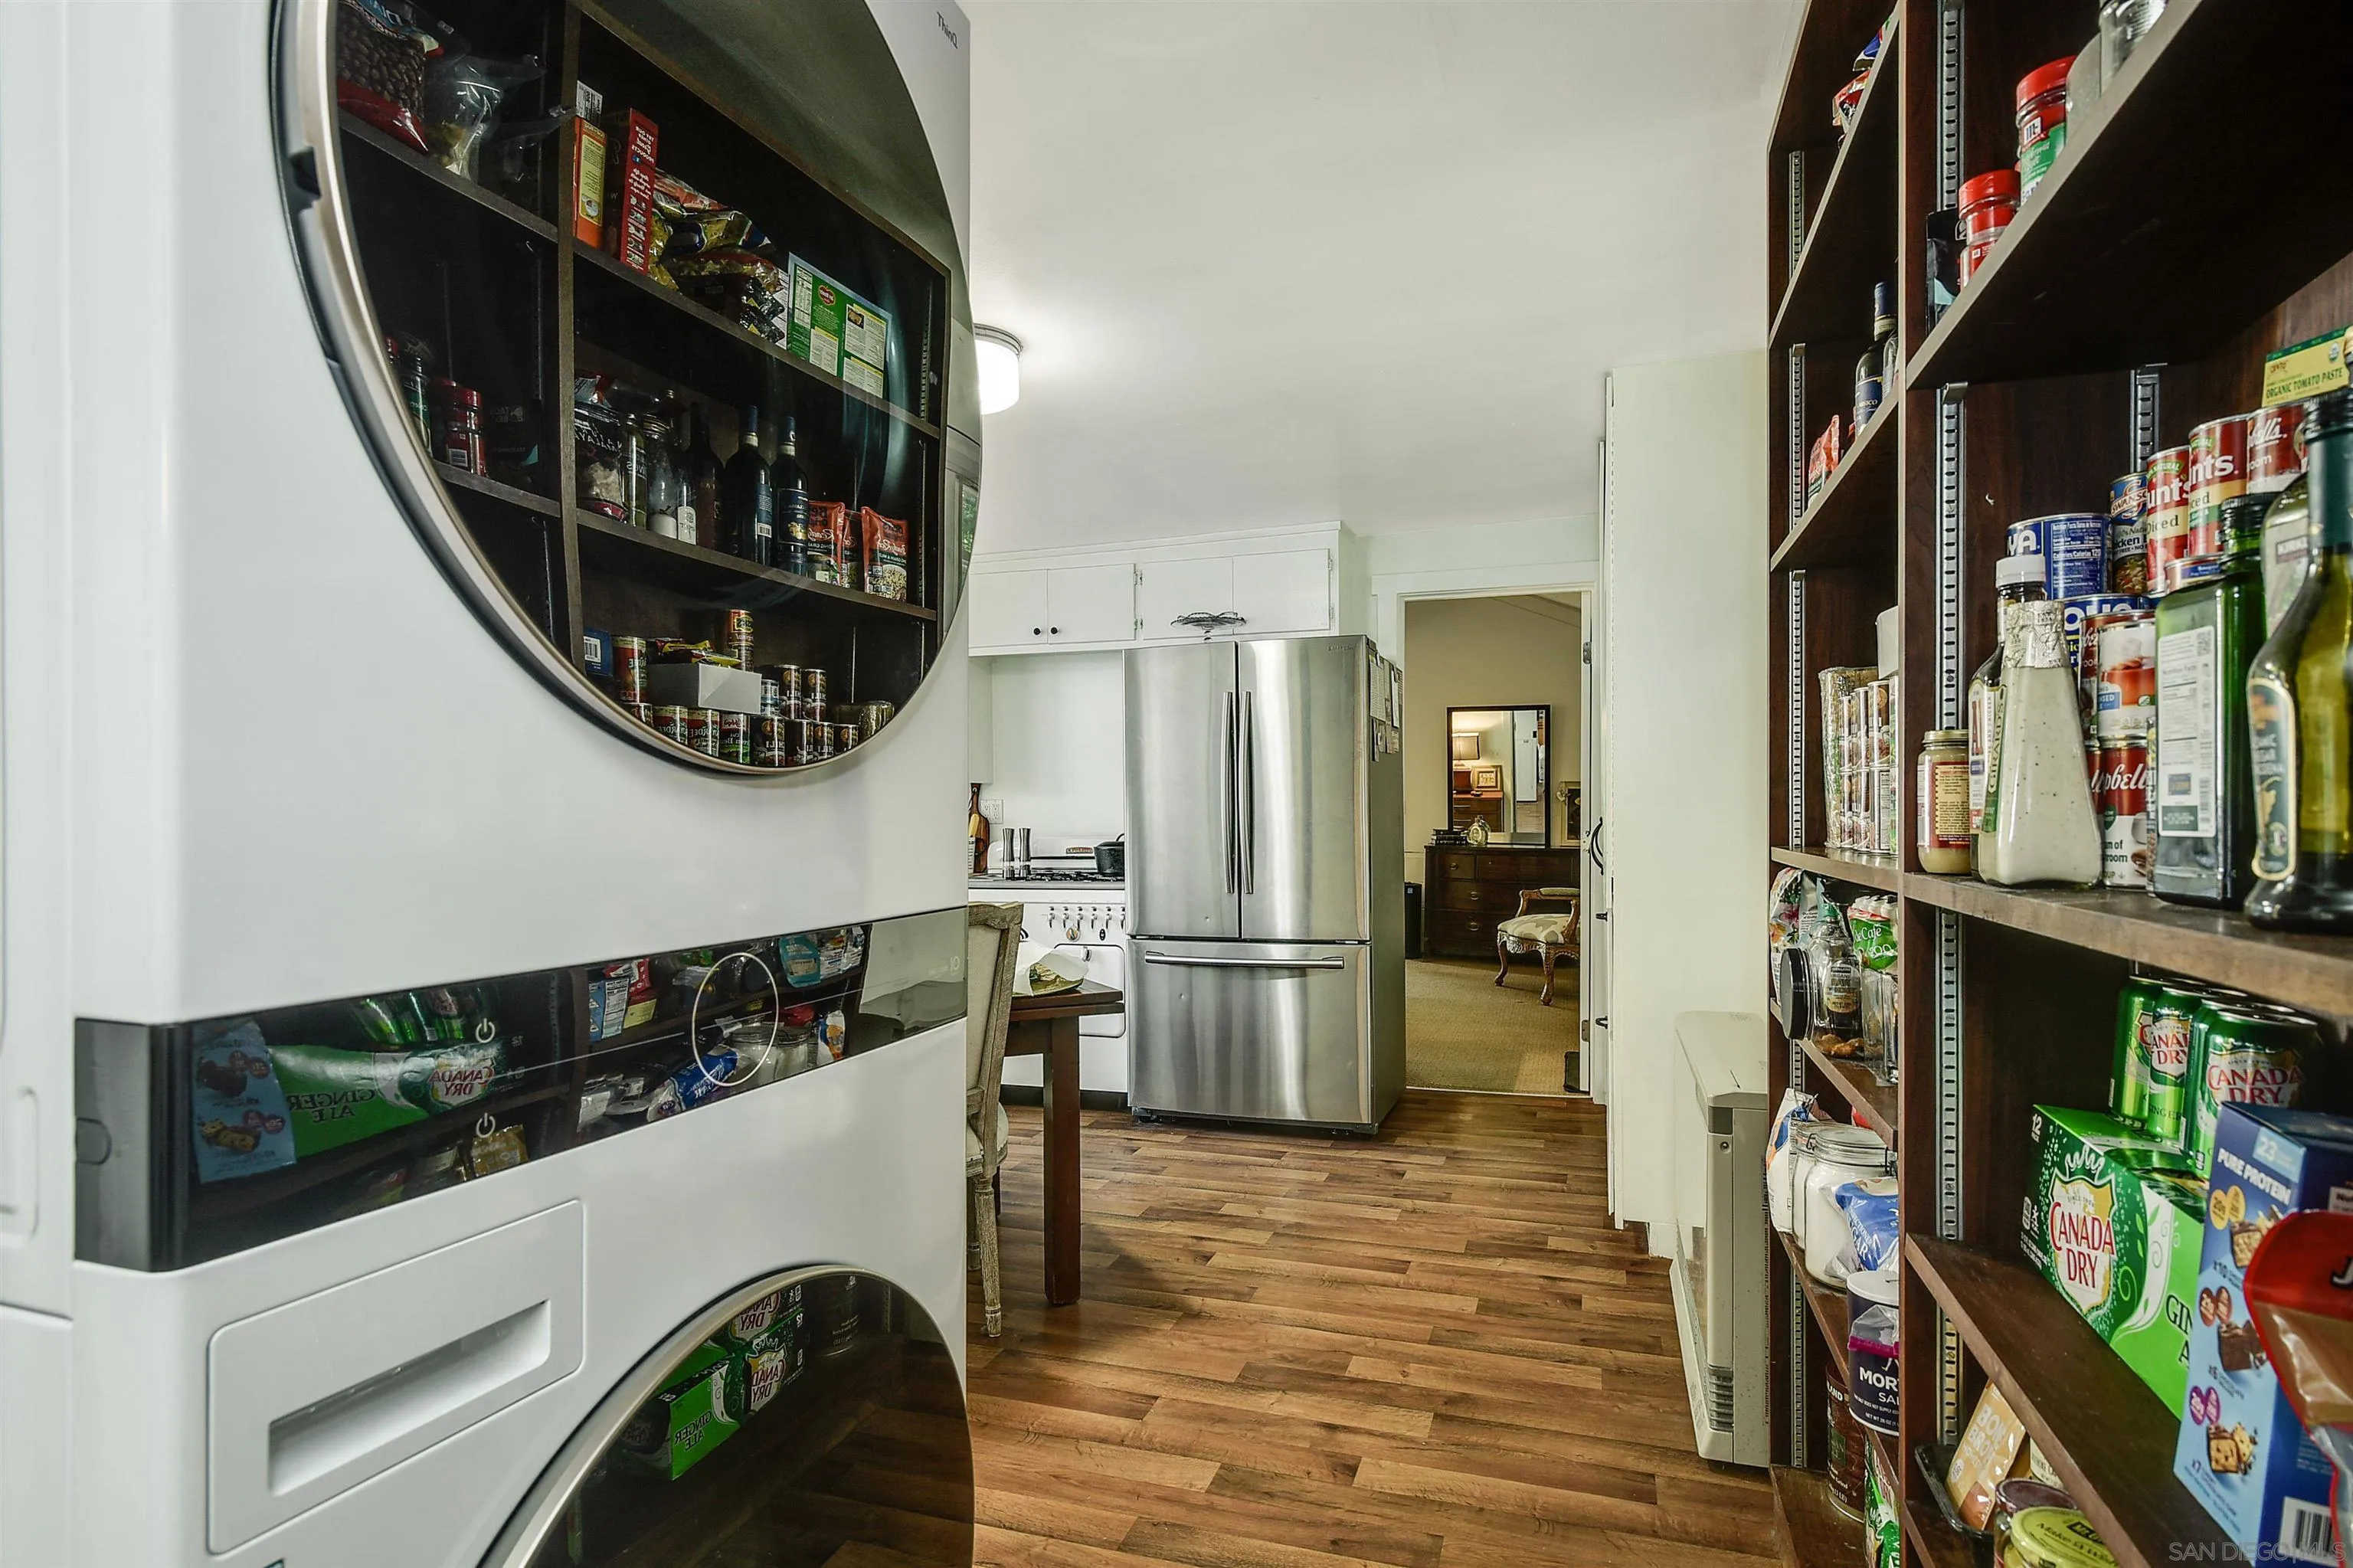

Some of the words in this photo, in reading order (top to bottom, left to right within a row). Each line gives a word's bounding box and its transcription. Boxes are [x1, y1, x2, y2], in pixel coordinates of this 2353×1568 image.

[937, 11, 957, 49] ThinQ
[2266, 383, 2292, 399] ORGANIC
[2294, 375, 2321, 391] TOMATO
[2322, 367, 2343, 383] PASTE
[1989, 702, 2003, 789] GIRARD'S
[2114, 840, 2123, 849] of
[2206, 1065, 2303, 1090] CANADA
[2227, 1086, 2283, 1105] DRY
[2031, 1113, 2041, 1133] 12
[2256, 1135, 2277, 1164] 23
[2217, 1147, 2244, 1177] PURE
[2243, 1165, 2292, 1206] PROTEIN
[2049, 1200, 2116, 1256] CANADA
[2066, 1247, 2097, 1288] DRY
